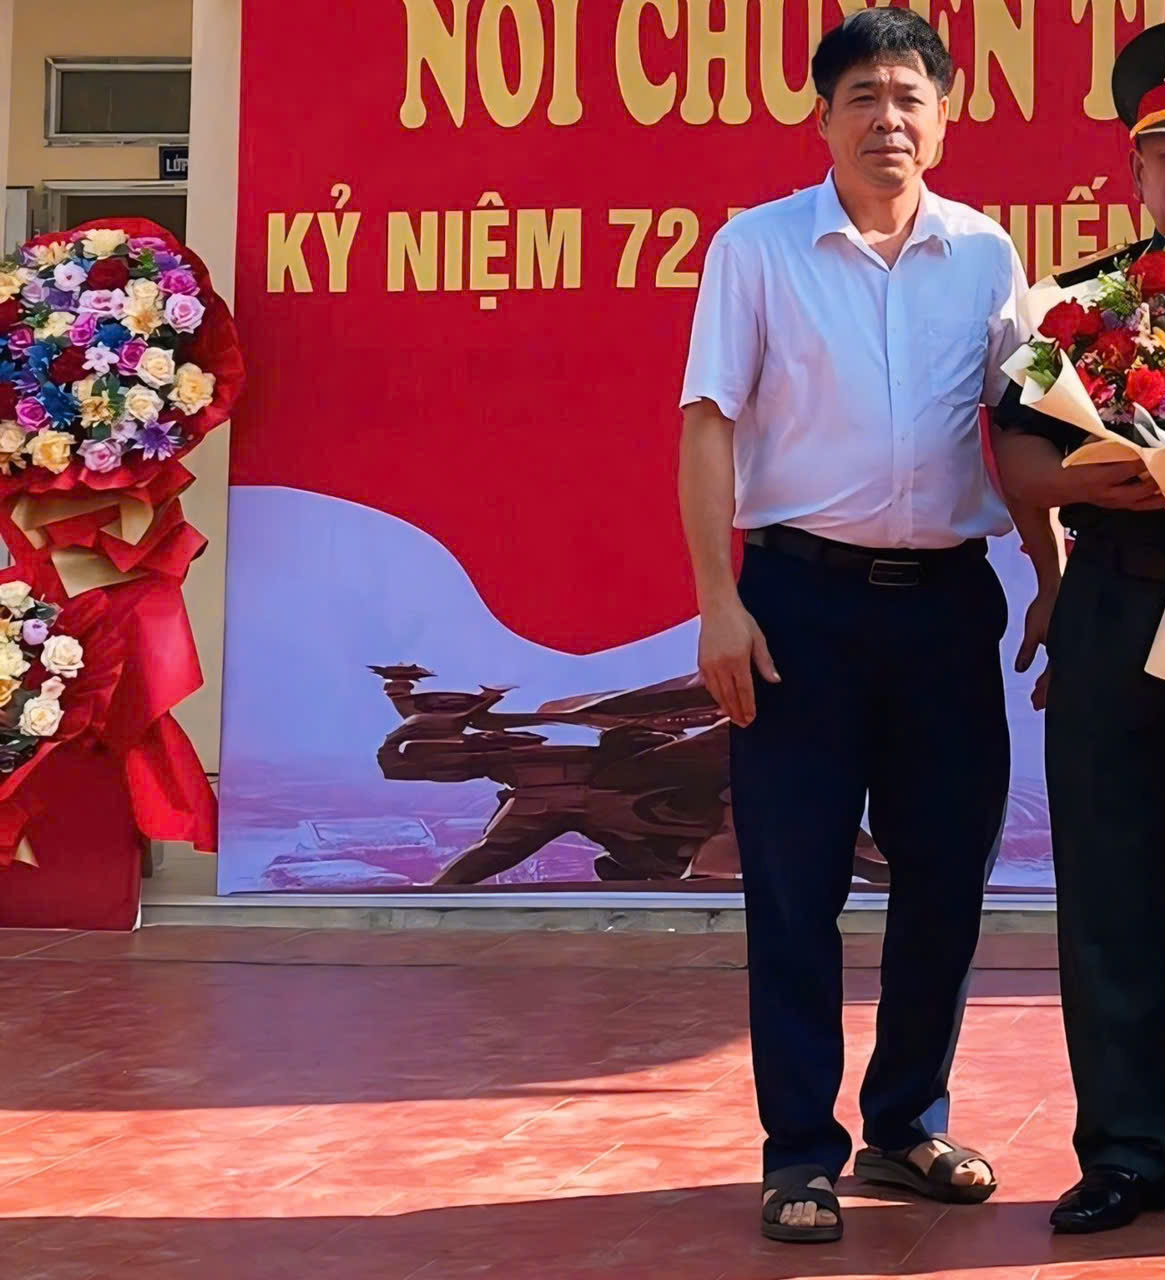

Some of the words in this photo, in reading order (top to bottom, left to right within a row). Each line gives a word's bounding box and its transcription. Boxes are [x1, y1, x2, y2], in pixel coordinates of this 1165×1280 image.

[266, 183, 361, 293] KỶ
[387, 191, 582, 310] NIỆM
[608, 207, 699, 288] 72
